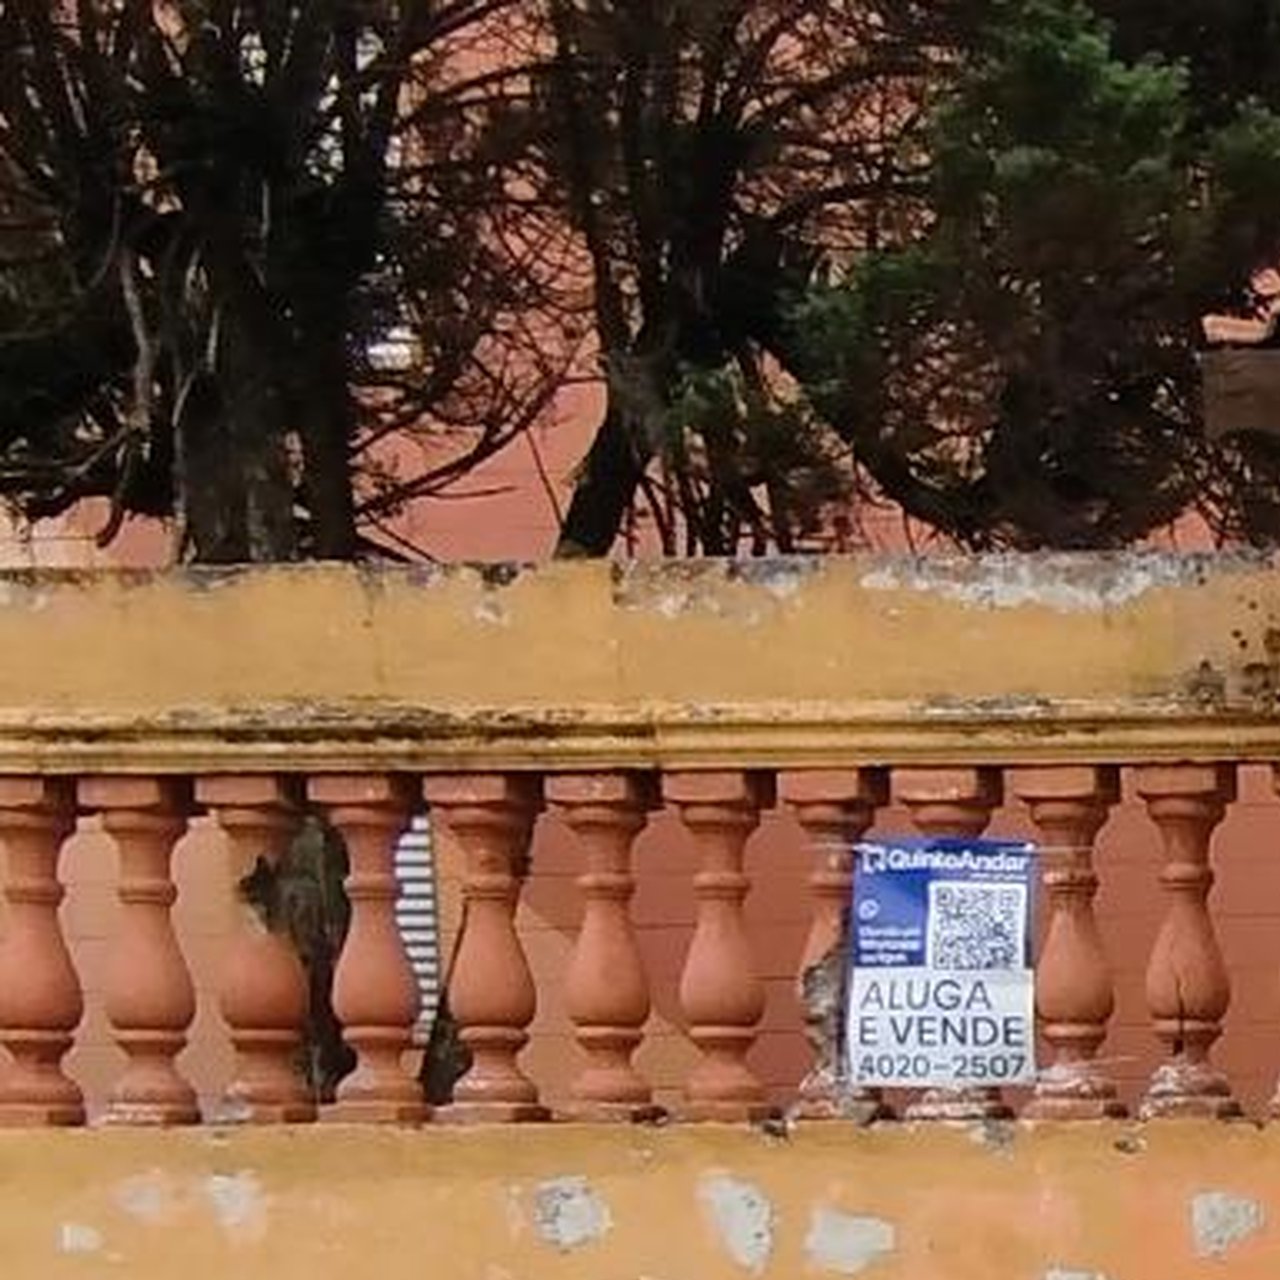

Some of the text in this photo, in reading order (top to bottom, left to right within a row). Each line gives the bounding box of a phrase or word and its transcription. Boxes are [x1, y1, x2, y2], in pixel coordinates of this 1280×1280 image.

[888, 848, 1029, 871] QuintoAndar
[860, 979, 993, 1011] ALUGA
[859, 1016, 1026, 1048] E VENDE
[859, 1054, 1027, 1079] 4020-2507
